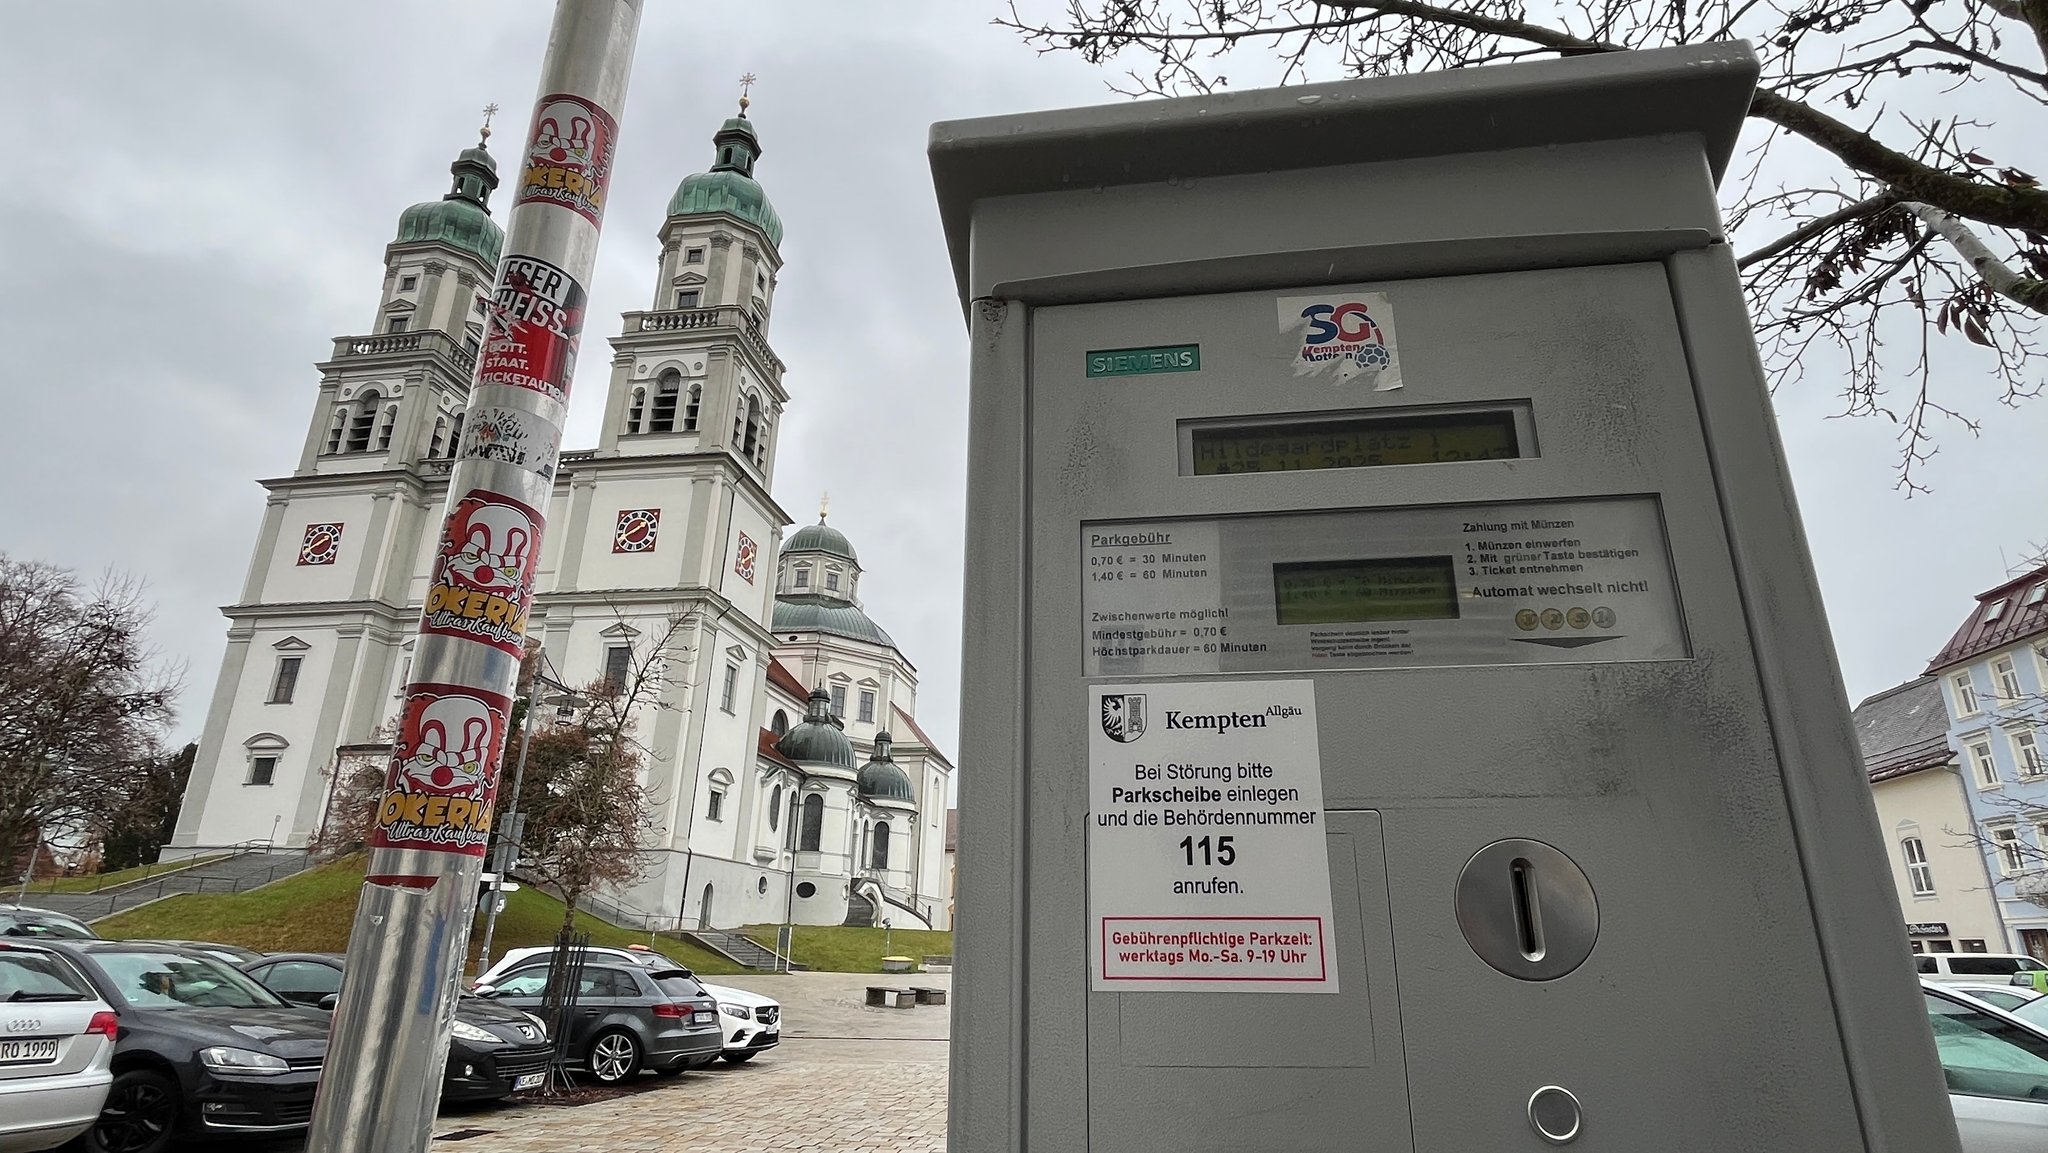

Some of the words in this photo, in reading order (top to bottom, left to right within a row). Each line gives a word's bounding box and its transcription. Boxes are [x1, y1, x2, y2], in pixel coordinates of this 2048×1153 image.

[1301, 303, 1371, 344] SG
[486, 356, 529, 371] STAAT.
[1092, 351, 1193, 374] SIEMENS
[1463, 523, 1508, 534] Zahlung
[1511, 521, 1529, 531] mit
[1531, 519, 1575, 530] Münzen
[1091, 532, 1171, 547] Parkgebühr
[1465, 542, 1475, 552] 1.
[1478, 540, 1522, 551] Münzen
[1525, 538, 1581, 549] einwerfen
[1091, 555, 1114, 567] 0,70
[1116, 555, 1123, 565] €
[1142, 554, 1156, 564] 30
[1162, 553, 1207, 563] Minuten
[1466, 554, 1477, 564] 2.
[1480, 553, 1498, 563] Mit
[1504, 551, 1541, 564] grüner
[1545, 551, 1575, 561] Taste
[1578, 548, 1639, 561] bestätigen
[1091, 571, 1114, 582] 1,40
[1116, 571, 1124, 581] €
[1142, 569, 1156, 580] 60
[1162, 568, 1208, 579] Minuten
[1469, 567, 1479, 576] 3.
[1482, 565, 1516, 575] Ticket
[1519, 563, 1584, 574] entnehmen
[1472, 585, 1535, 598] Automat
[1537, 581, 1604, 595] wechselt
[1607, 579, 1650, 593] nicht!
[1091, 610, 1176, 622] Zwischenwerte
[1179, 607, 1229, 621] möglich!
[1092, 627, 1177, 641] Mindestgebühr
[1193, 626, 1217, 639] 0,70
[1220, 626, 1227, 636] €
[1092, 644, 1190, 658] Höchstparkdauer
[1203, 643, 1217, 654] 60
[1220, 642, 1267, 653] Minuten
[1165, 710, 1267, 734] Kempten
[1266, 705, 1303, 718] Allgäu
[1135, 764, 1162, 780] Bei
[1167, 763, 1232, 783] Störung
[1237, 762, 1274, 779] bitte
[1112, 786, 1222, 803] Parkscheibe
[1227, 786, 1299, 805] einlegen
[1098, 811, 1128, 826] und
[1133, 811, 1158, 826] die
[1163, 809, 1317, 826] Behördennummer
[389, 821, 431, 839] Ultras
[1179, 835, 1237, 866] 115
[1173, 877, 1244, 894] anrufen.
[1112, 931, 1246, 948] Gebührenpflichtige
[1249, 931, 1313, 946] Parkzeit:
[1119, 951, 1184, 965] werktags
[1188, 949, 1243, 963] Mo.-Sa.
[1246, 949, 1276, 963] 9-19
[1280, 949, 1308, 963] Uhr
[23, 1041, 56, 1058] 1999
